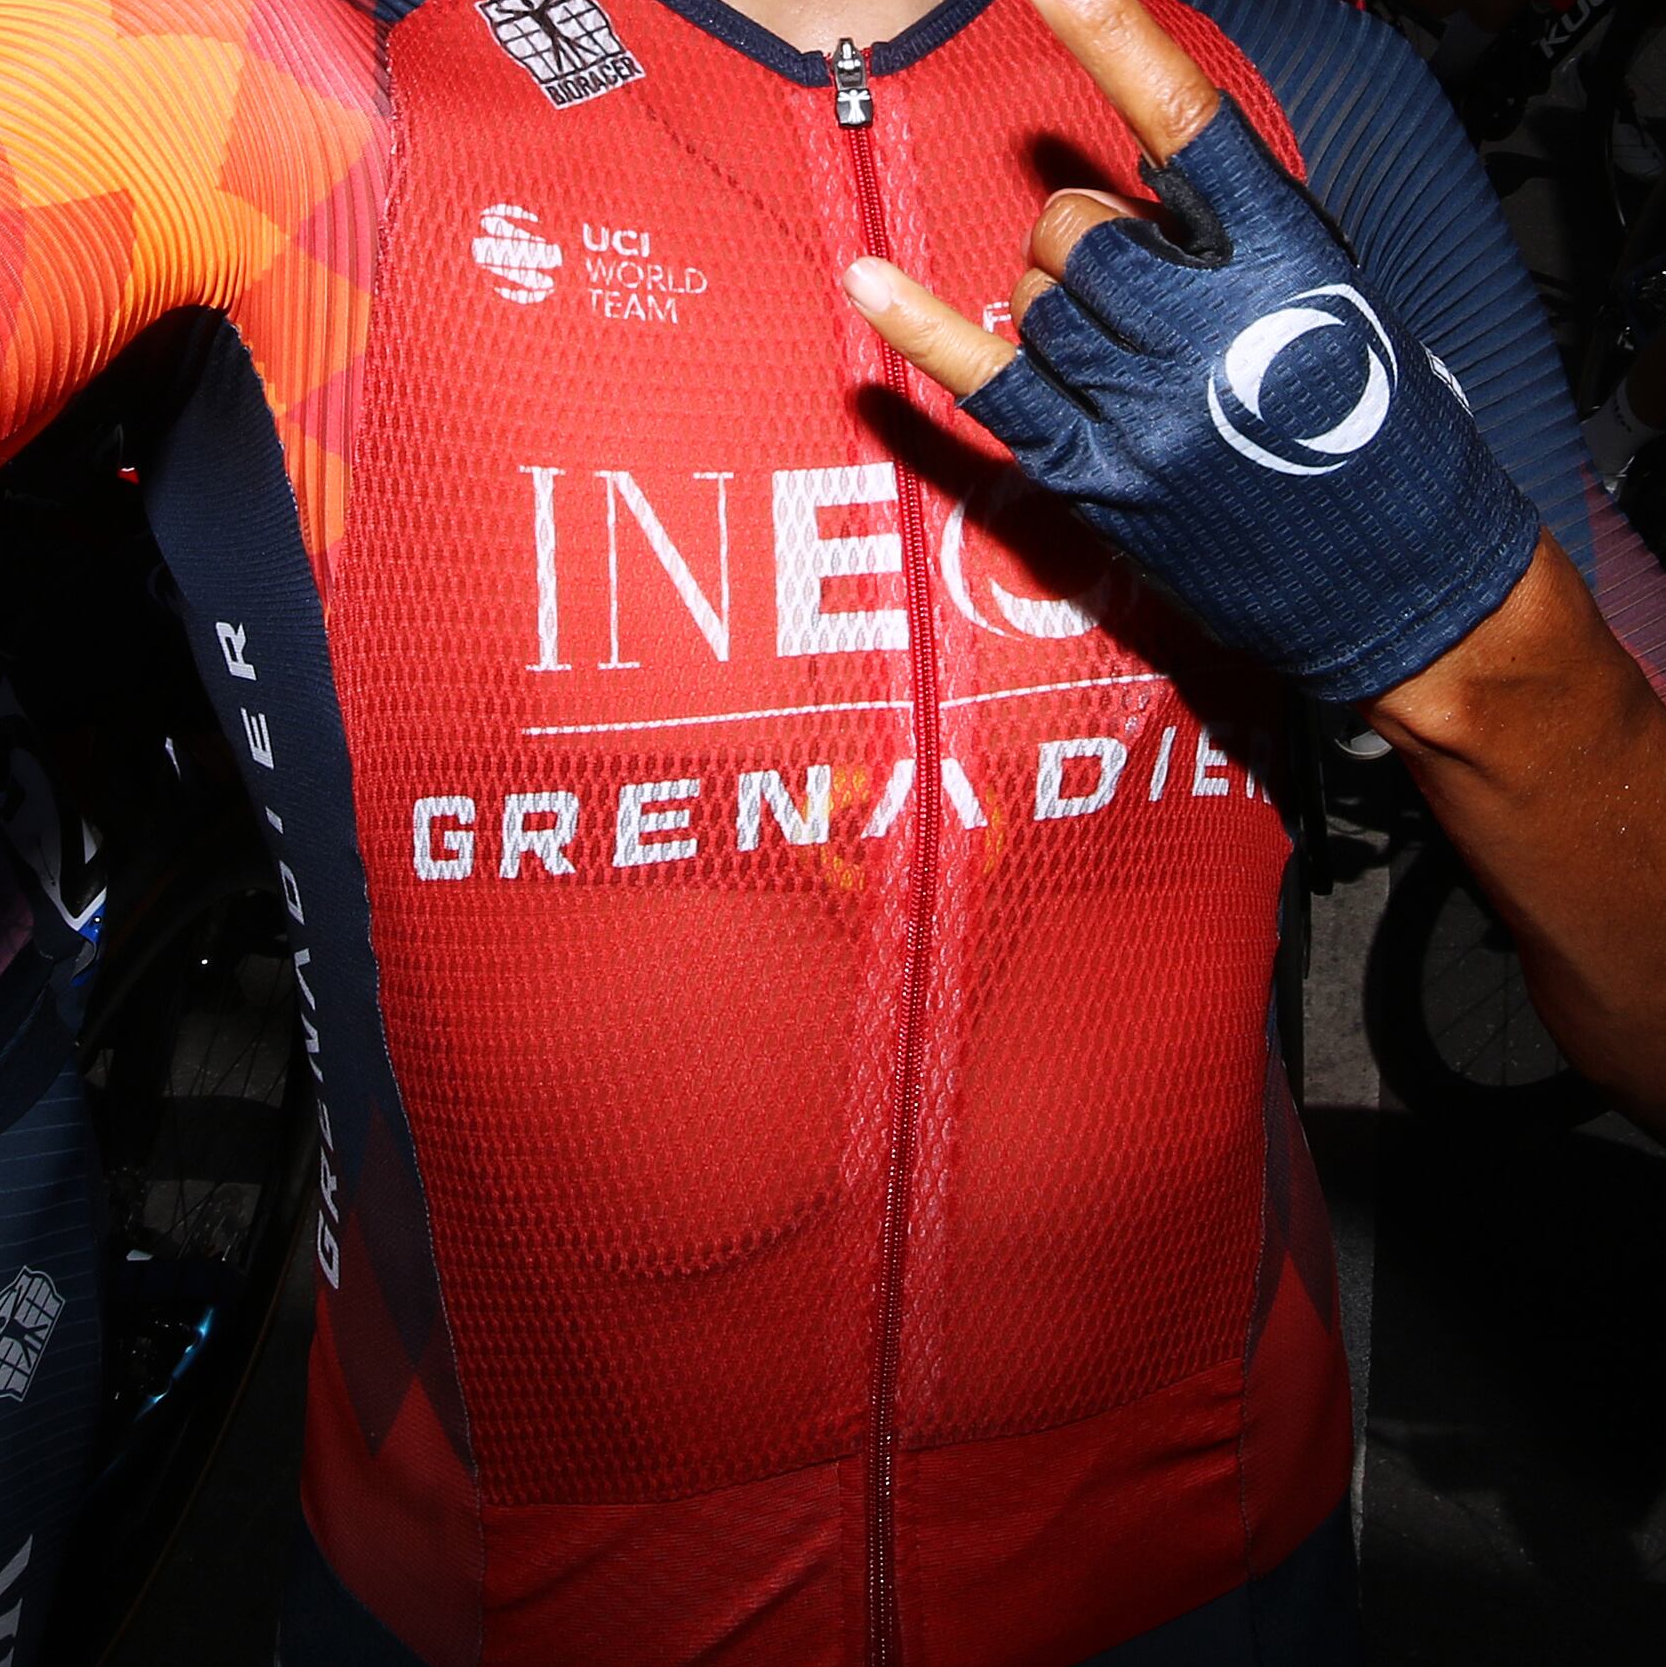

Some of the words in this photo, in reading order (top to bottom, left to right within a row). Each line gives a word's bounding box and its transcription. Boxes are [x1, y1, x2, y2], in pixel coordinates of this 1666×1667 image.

[544, 55, 645, 109] BIORACER
[582, 222, 651, 259] UCI
[585, 263, 708, 297] WORLD
[587, 289, 679, 324] TEAM
[518, 461, 1115, 672] INEO
